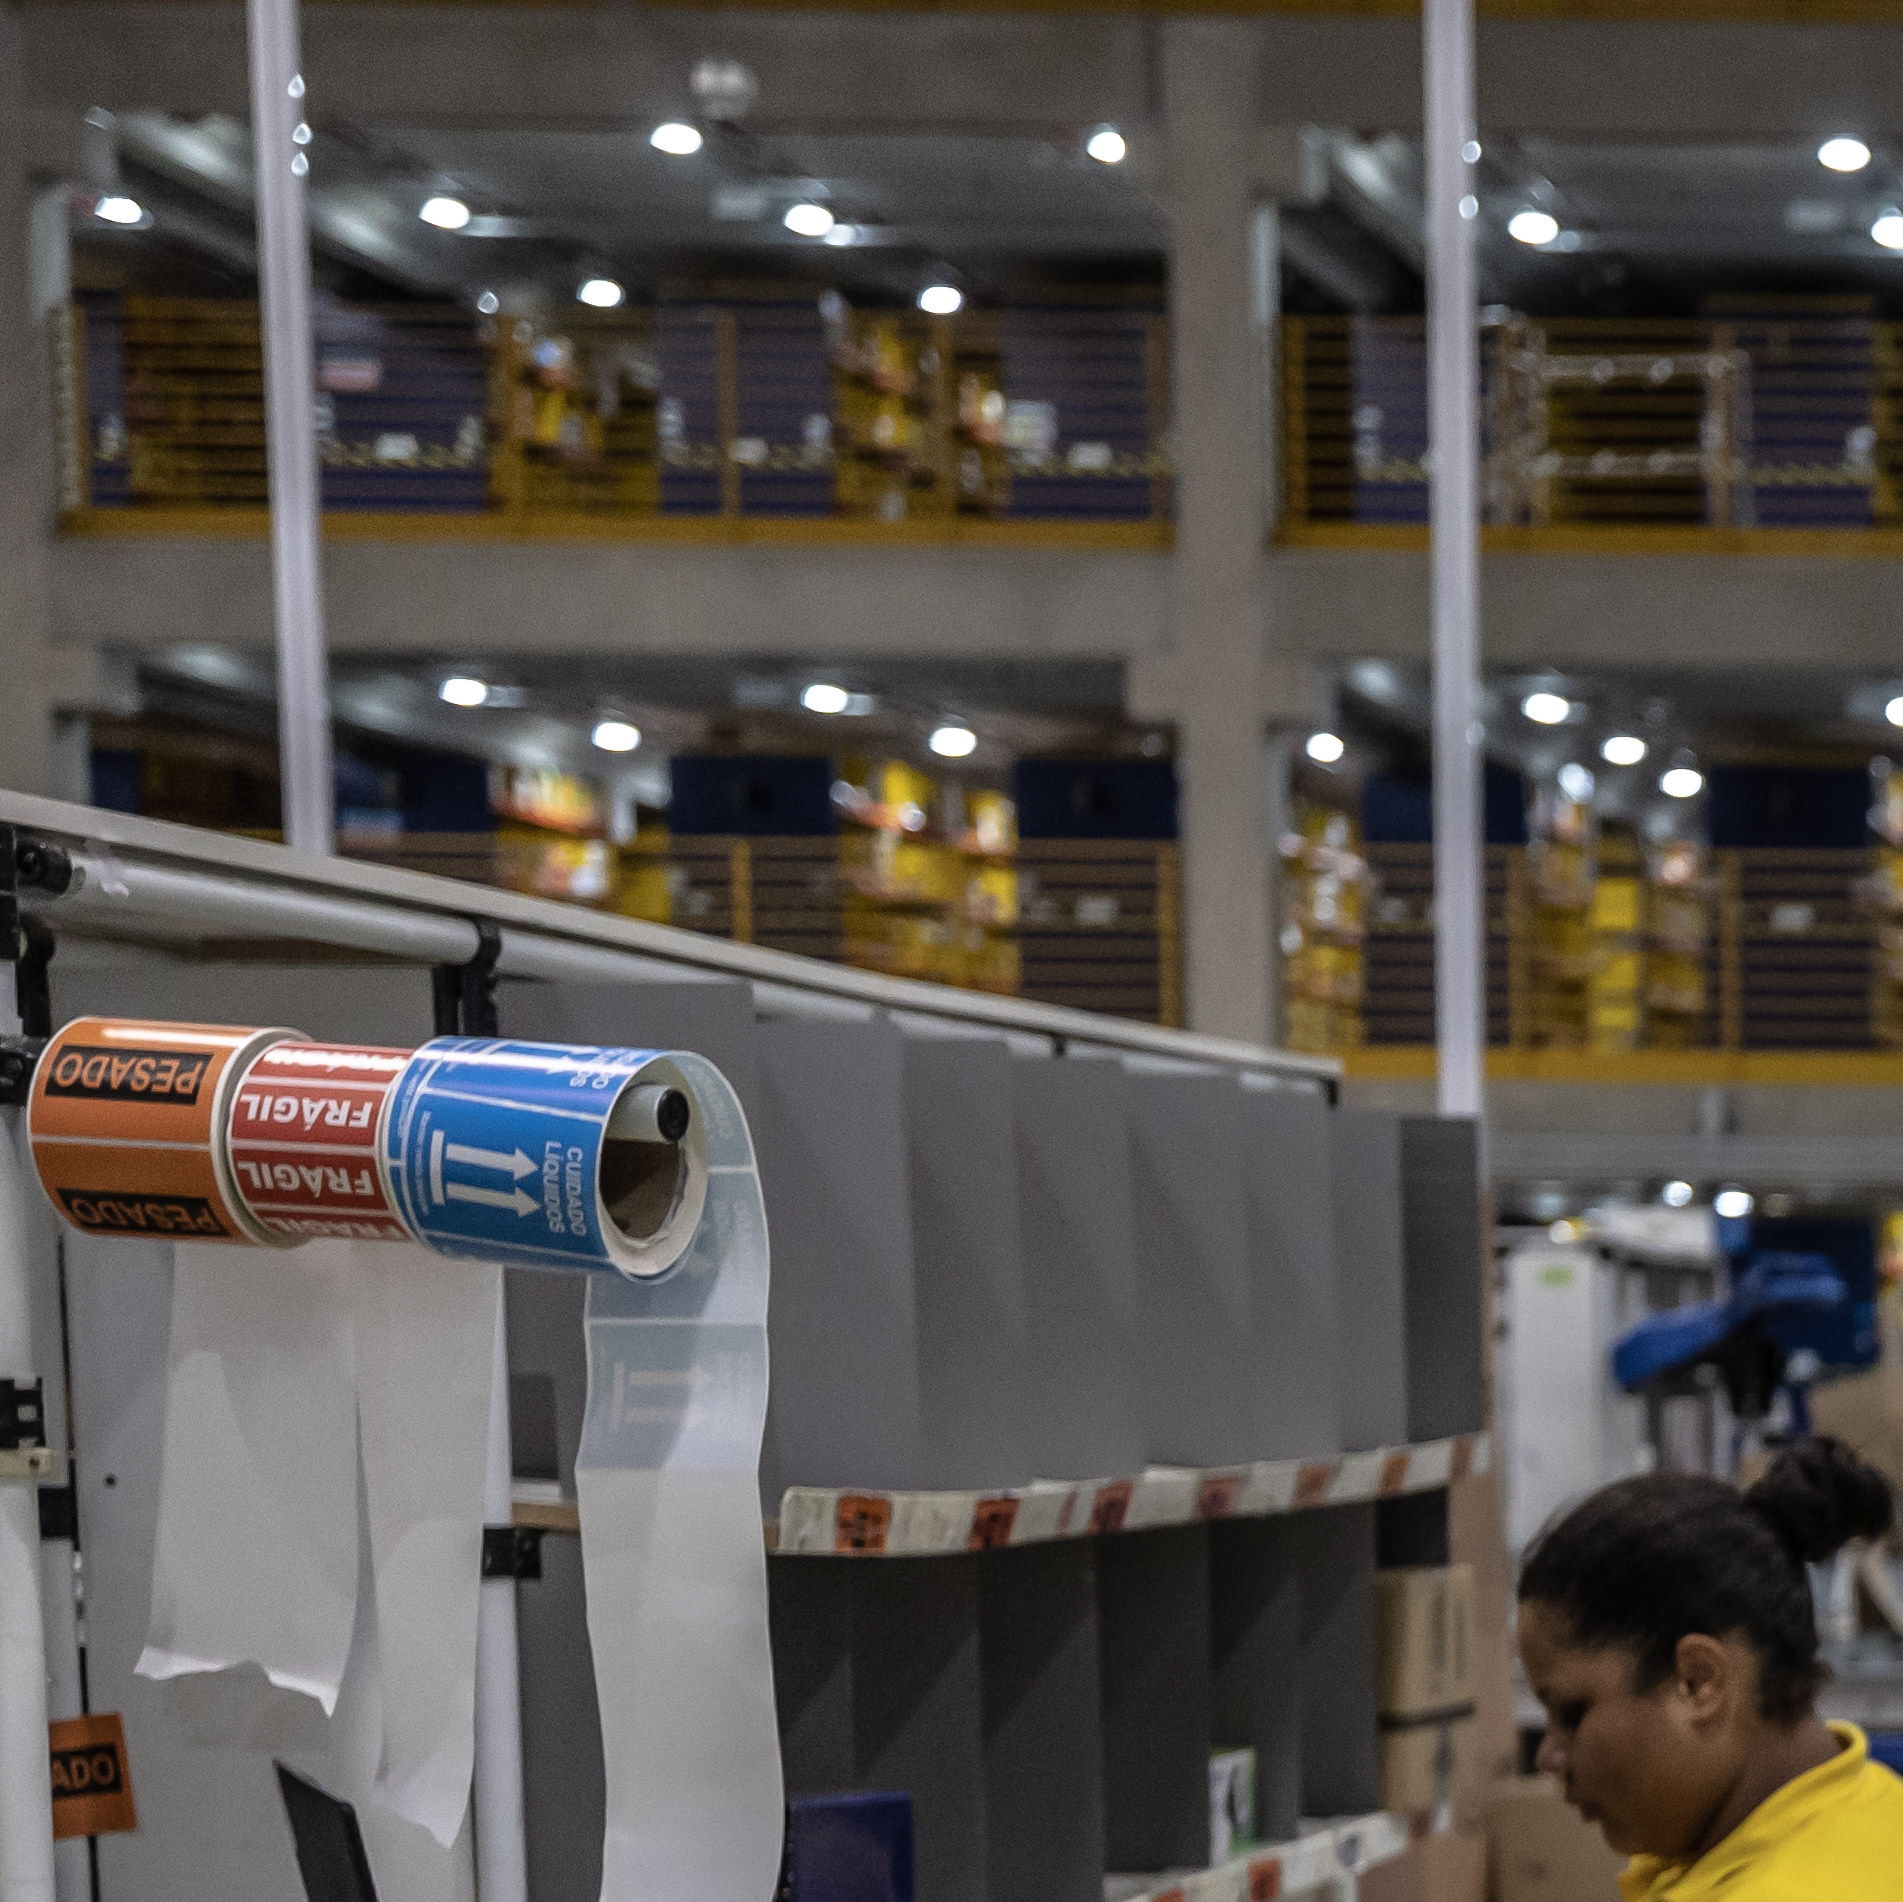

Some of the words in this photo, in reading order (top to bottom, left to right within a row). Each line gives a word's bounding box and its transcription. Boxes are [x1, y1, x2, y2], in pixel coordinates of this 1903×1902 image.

[55, 1052, 202, 1095] PESADO
[240, 1094, 372, 1131] FRÁGIL
[238, 1161, 375, 1198] FRÁGIL
[51, 1752, 116, 1790] ADO
